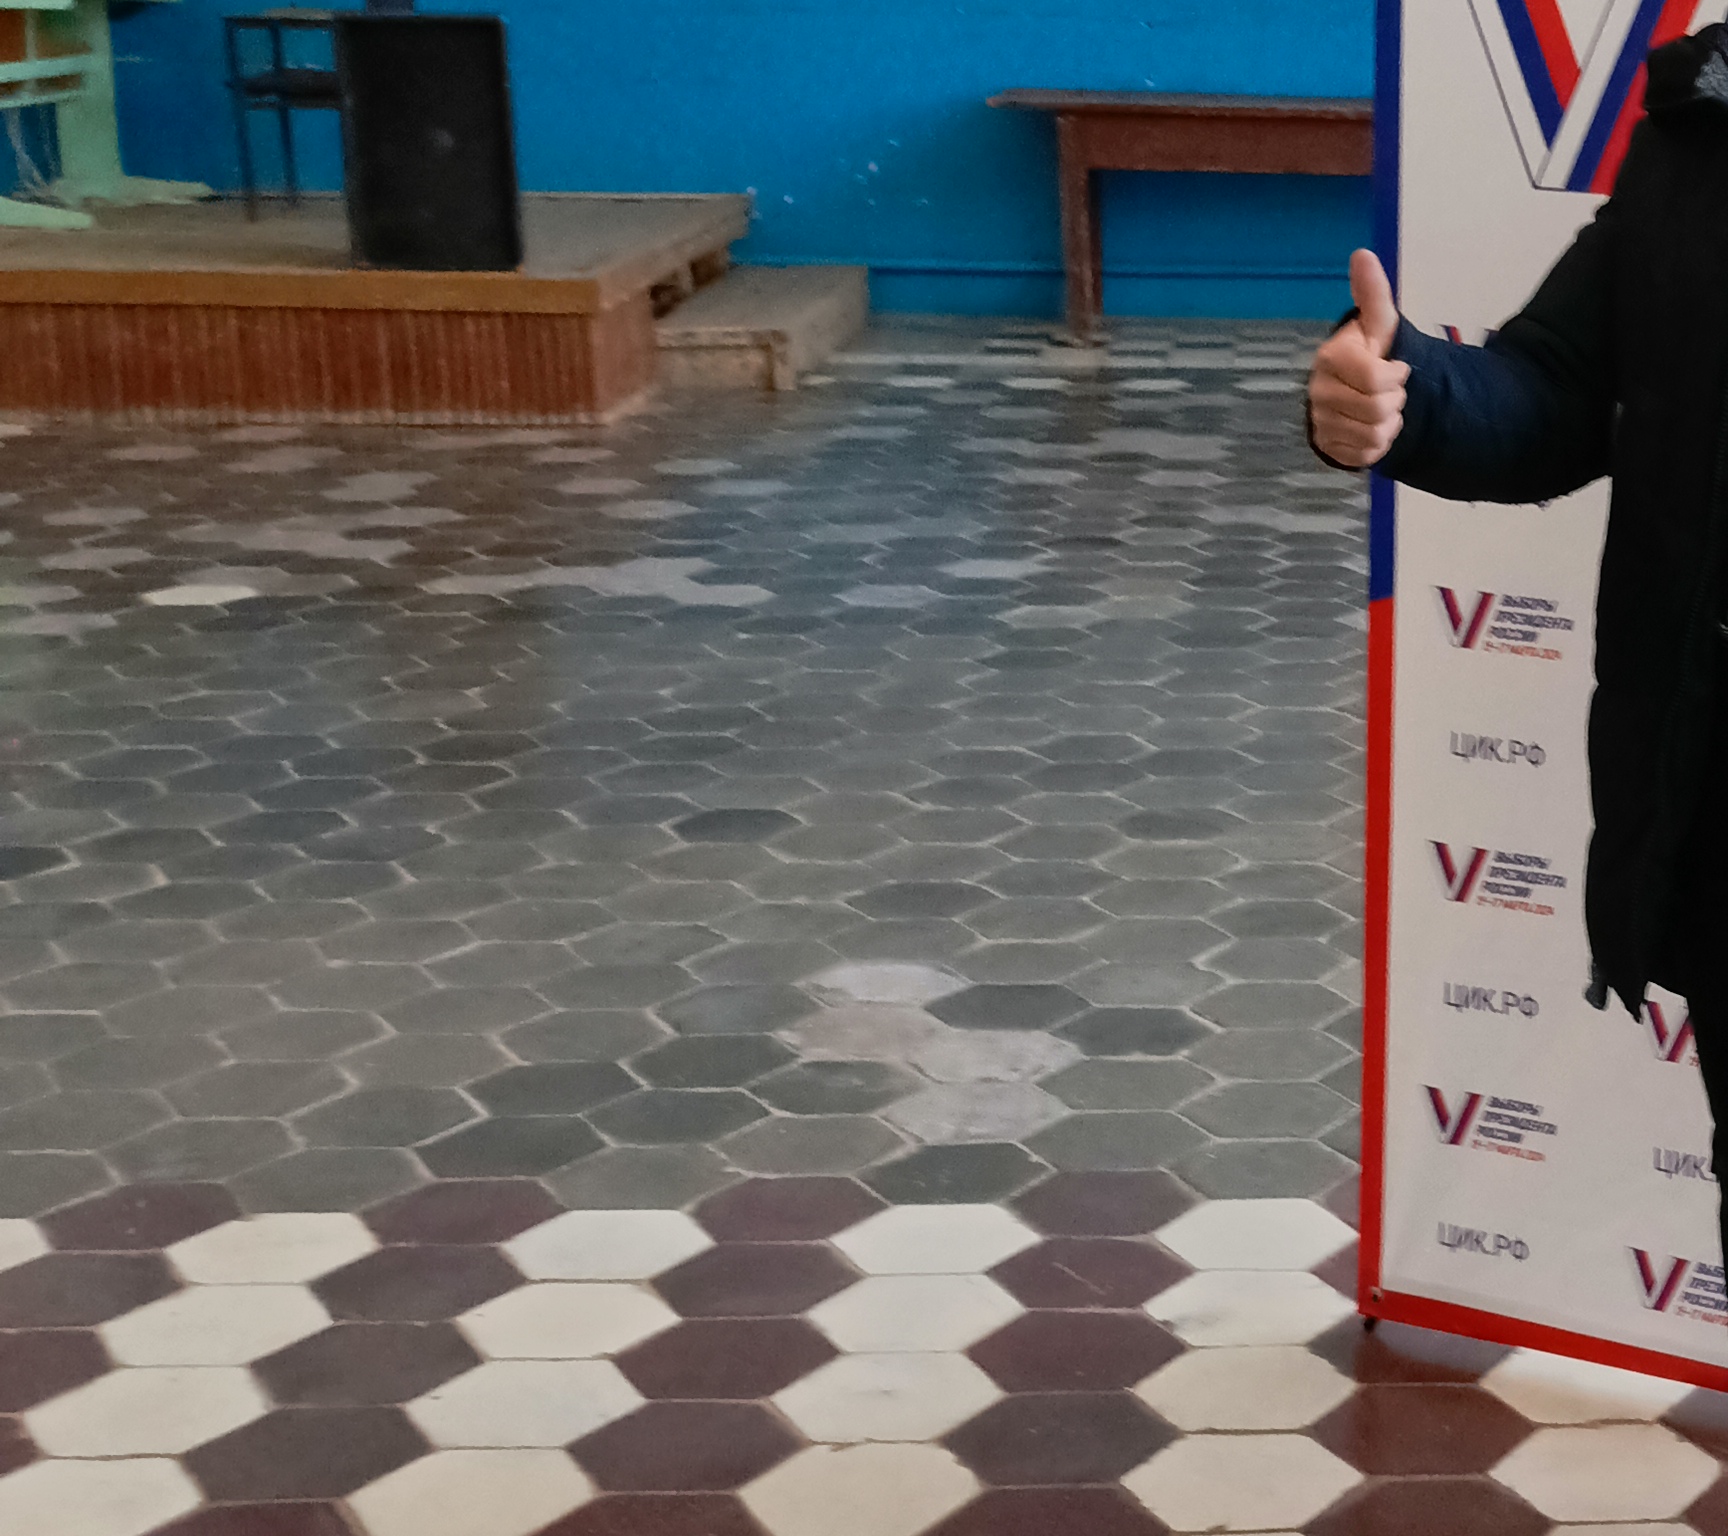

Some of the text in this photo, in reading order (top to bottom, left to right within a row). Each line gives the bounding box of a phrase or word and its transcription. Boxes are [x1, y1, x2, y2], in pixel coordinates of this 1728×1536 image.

[1450, 731, 1546, 768] ЦИК.РФ
[1443, 982, 1540, 1019] ЦИК.РФ
[1438, 1221, 1530, 1263] ЦИК.РФ
